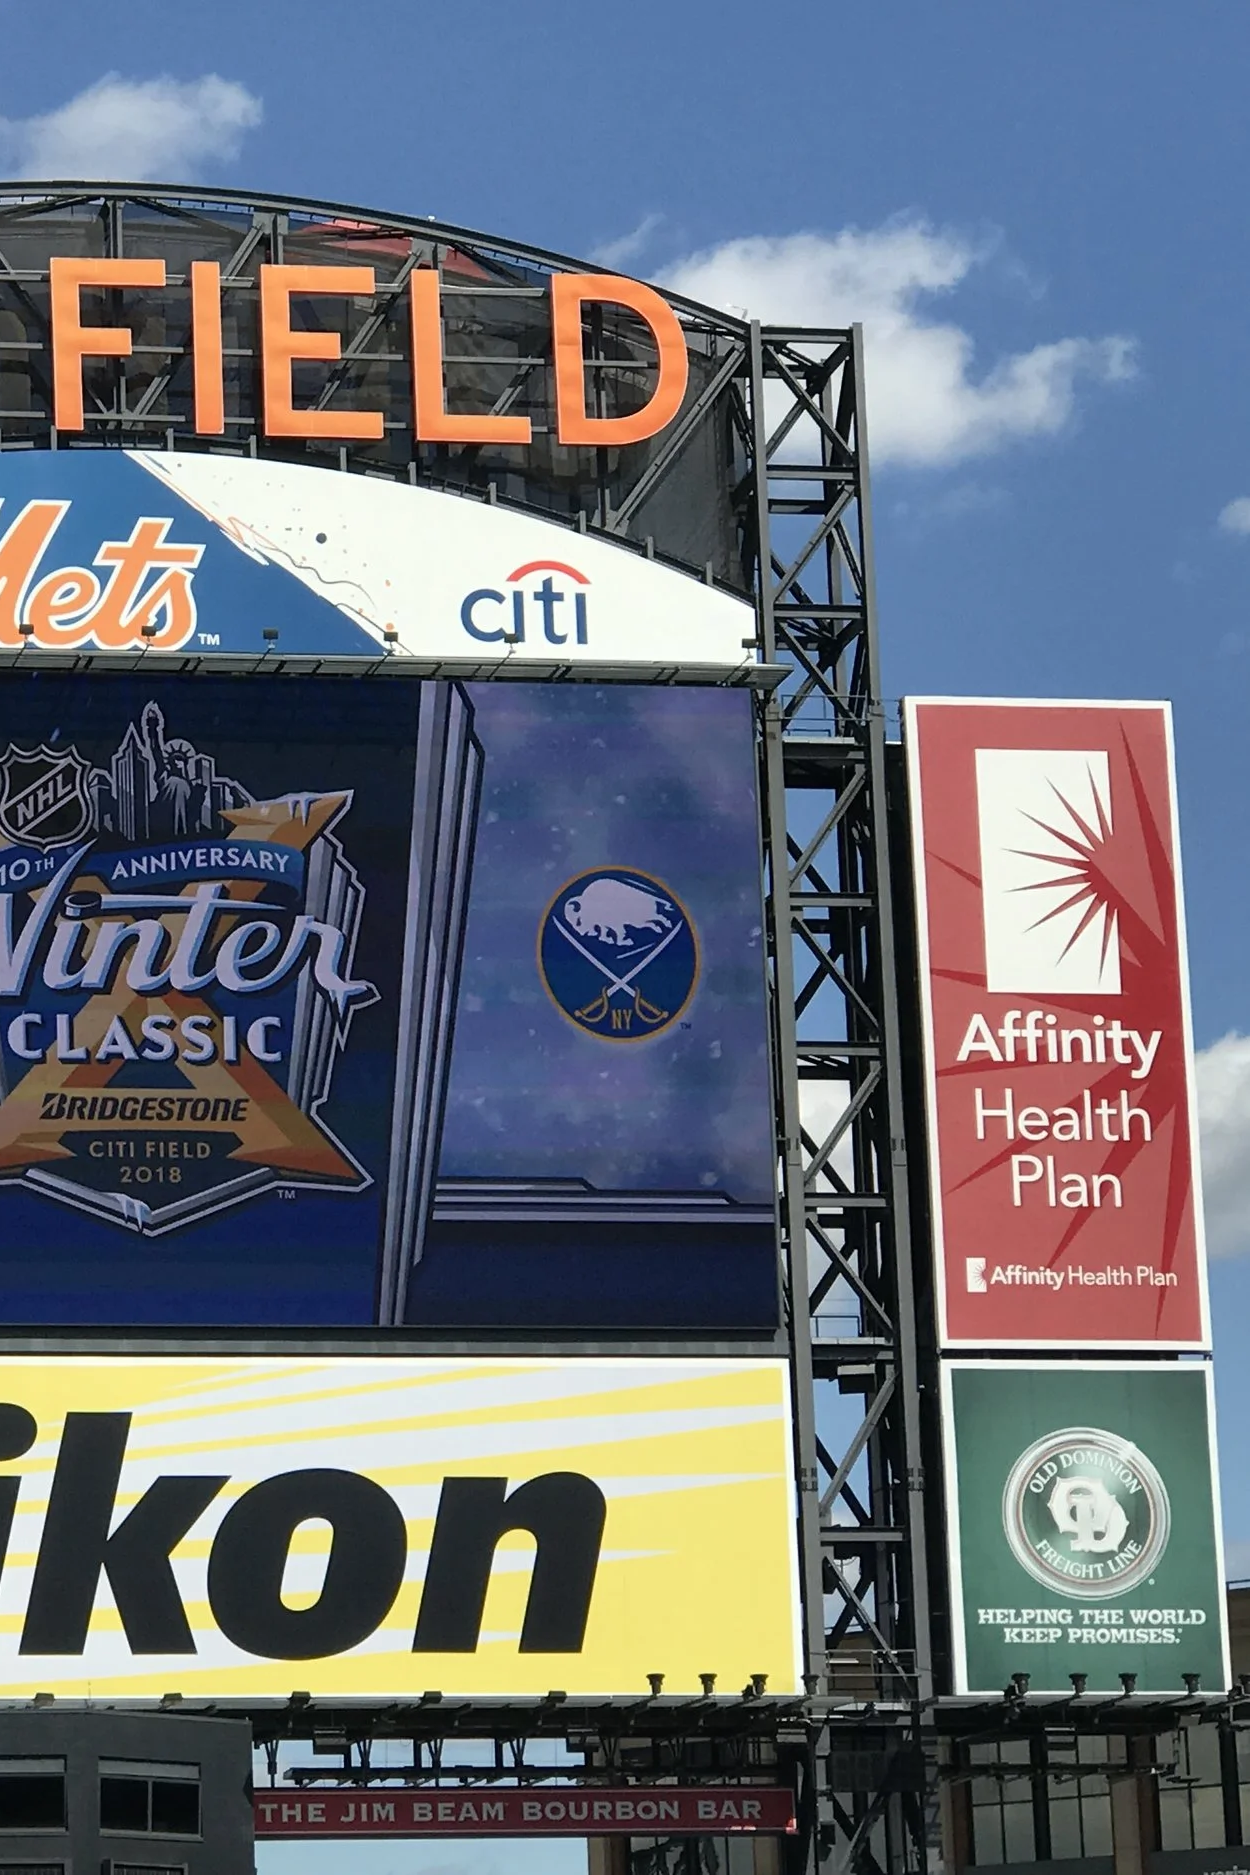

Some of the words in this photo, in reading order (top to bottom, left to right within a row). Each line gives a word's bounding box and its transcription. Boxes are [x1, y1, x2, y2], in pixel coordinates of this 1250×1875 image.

[49, 258, 689, 447] FIELD
[460, 576, 589, 645] citi
[15, 770, 73, 828] NHL
[110, 847, 290, 881] ANNIVERSARY
[6, 1012, 283, 1063] CLASSIC
[611, 1008, 633, 1031] NY
[956, 1010, 1163, 1079] Affinity
[40, 1091, 250, 1122] BRIDGESTONE
[974, 1087, 1152, 1142] Health
[88, 1140, 136, 1159] CITI
[145, 1140, 213, 1159] FIELD
[119, 1165, 183, 1185] 2018
[1011, 1154, 1123, 1208] Plan
[989, 1265, 1066, 1291] Affinity
[1068, 1265, 1133, 1287] Health
[1136, 1265, 1178, 1287] Plan
[1029, 1461, 1060, 1494] OLD
[1059, 1450, 1143, 1496] DOMINION
[1034, 1539, 1105, 1579] FREIGHT
[1106, 1538, 1142, 1575] LINE
[978, 1609, 1073, 1625] HELPING
[1079, 1609, 1124, 1625] THE
[1129, 1609, 1206, 1625] WORLD
[1004, 1628, 1062, 1644] KEEP
[1068, 1628, 1181, 1644] PROMISES.
[258, 1803, 327, 1823] THE
[340, 1803, 396, 1823] JIM
[413, 1802, 505, 1822] BEAM
[522, 1800, 680, 1821] BOURBON
[698, 1800, 762, 1820] BAR
